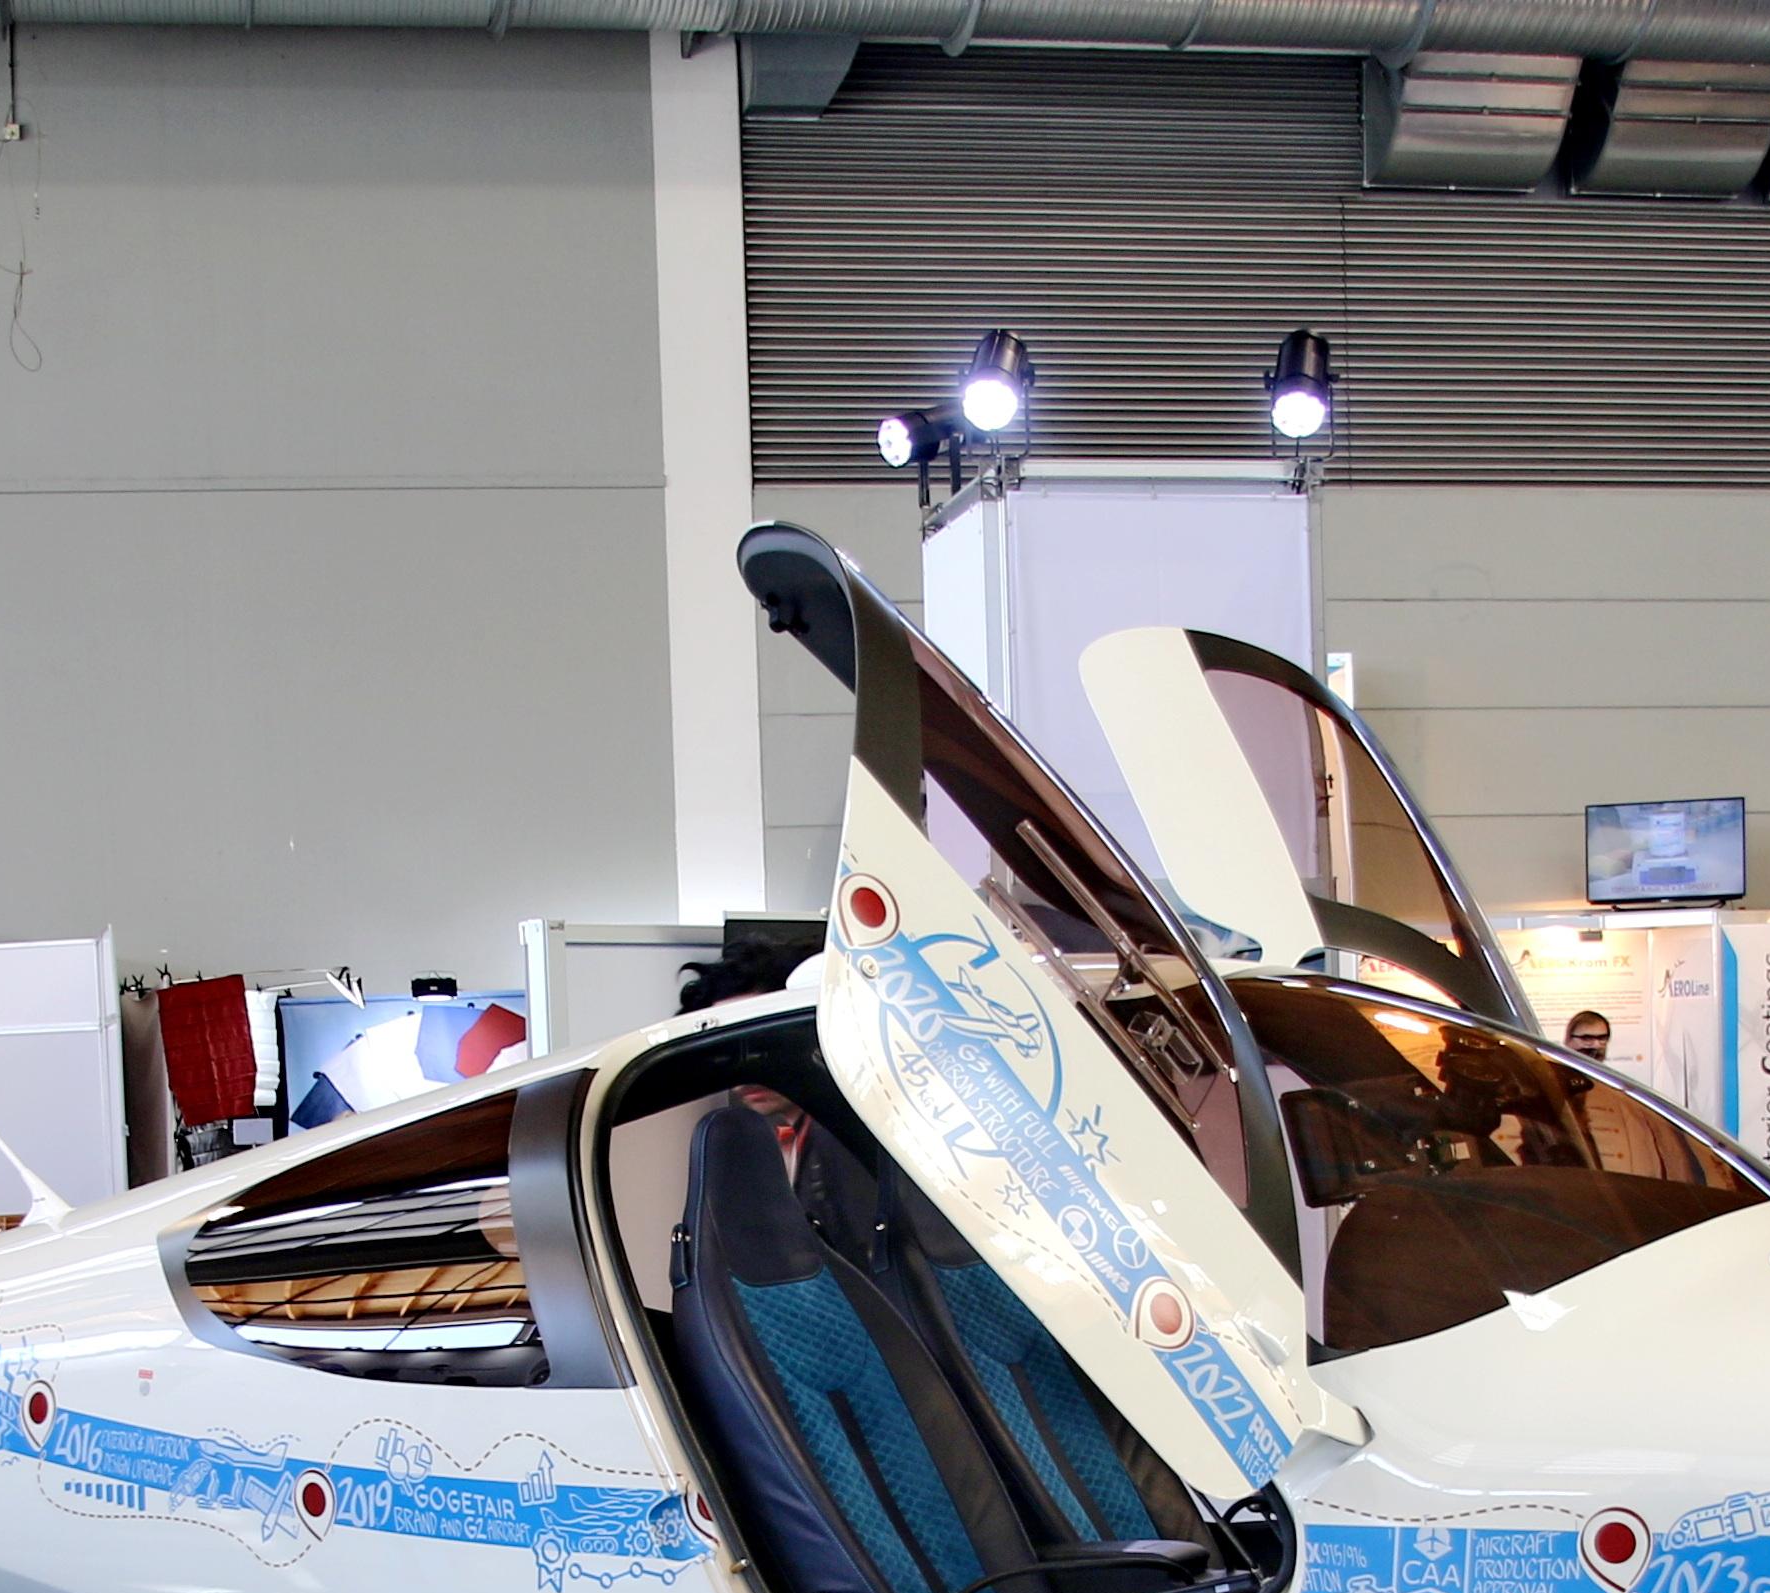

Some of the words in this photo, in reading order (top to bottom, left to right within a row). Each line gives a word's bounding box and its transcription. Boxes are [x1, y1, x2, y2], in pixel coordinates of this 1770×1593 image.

[925, 1037, 980, 1098] CARBON
[970, 1097, 1060, 1200] STRUCTURE
[958, 1043, 991, 1074] G3
[984, 1068, 1024, 1115] WITH
[1016, 1107, 1060, 1160] FULL
[1172, 1338, 1254, 1441] 2022
[55, 1412, 104, 1473] 2016
[336, 1476, 394, 1528] 2019
[413, 1484, 516, 1521] GOGETAIR
[393, 1506, 438, 1535] BRAND
[440, 1518, 462, 1538] AND
[464, 1516, 488, 1540] G2
[487, 1519, 532, 1543] AIRCRAFT
[1321, 1544, 1368, 1569] 915/916
[1475, 1531, 1563, 1558] AIRCRAFT
[1402, 1560, 1461, 1588] CAA
[1474, 1558, 1580, 1580] PRODUCTION
